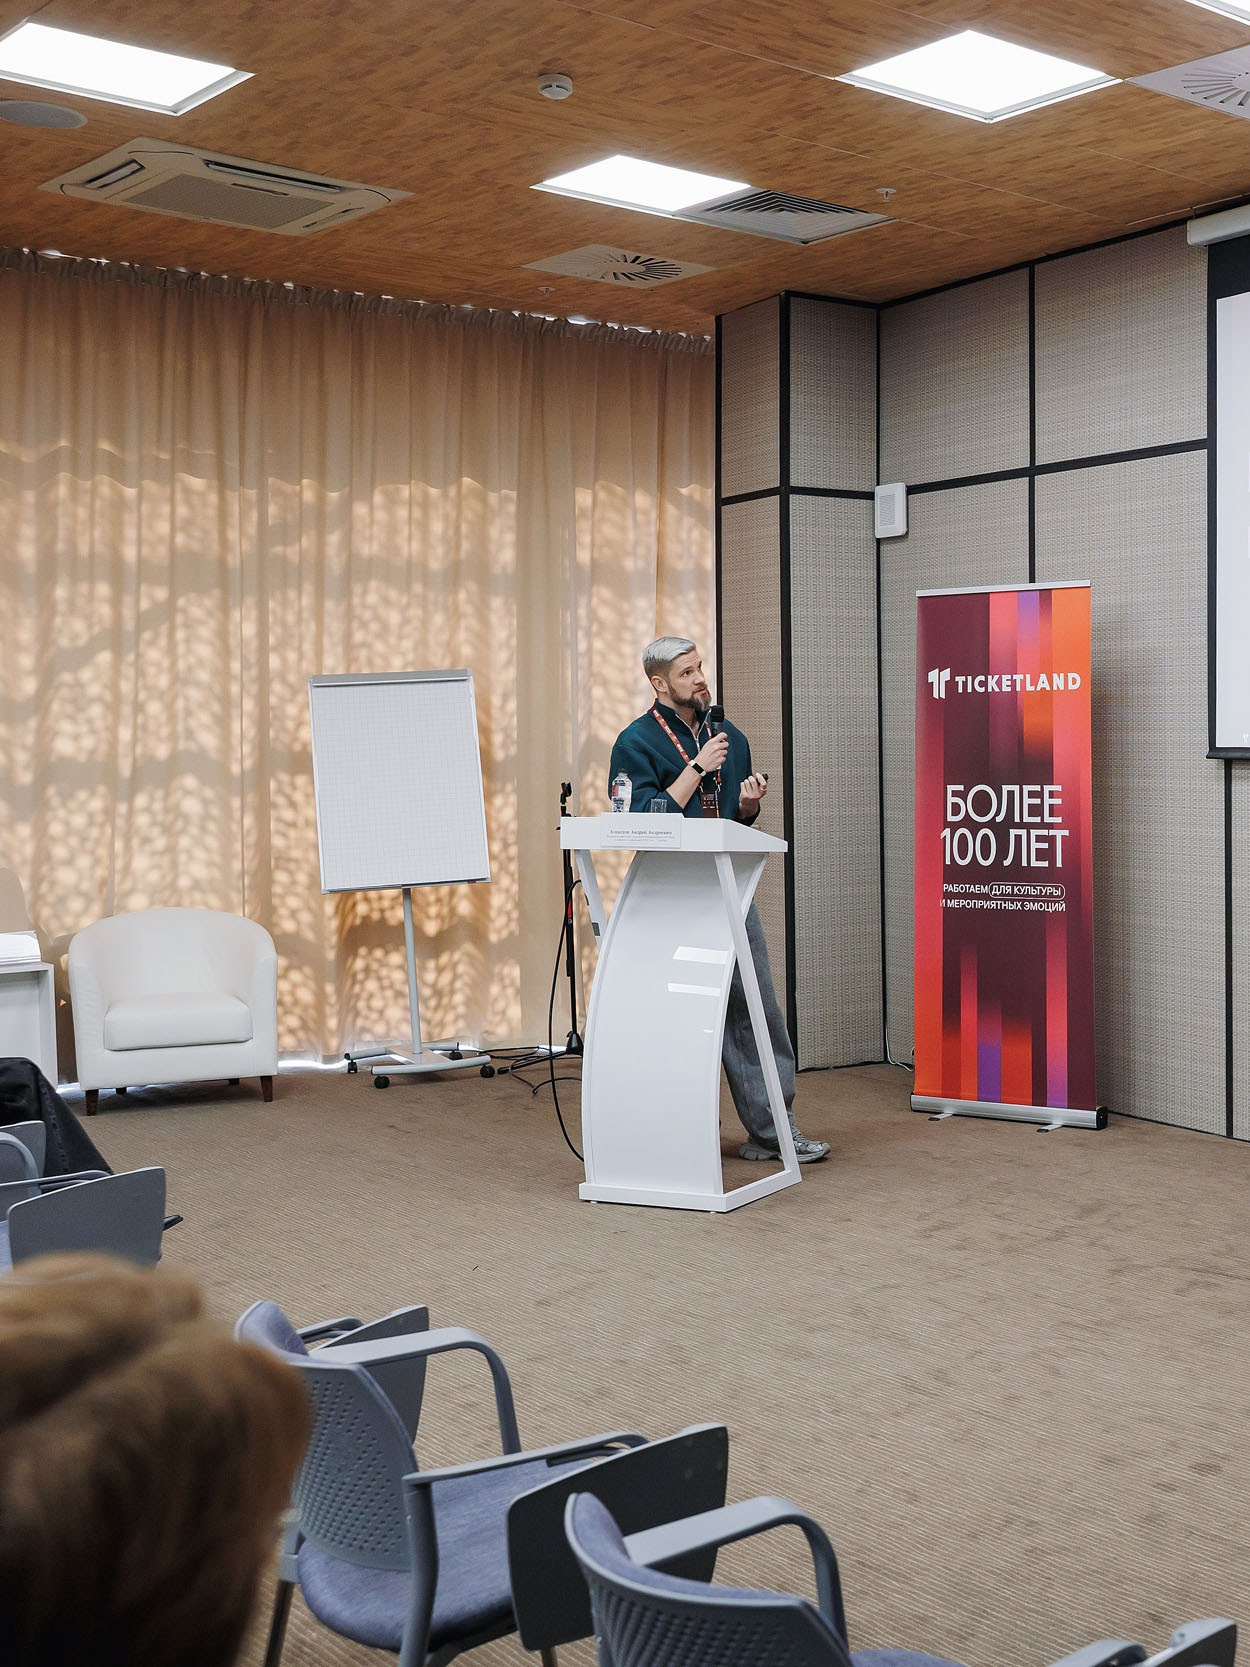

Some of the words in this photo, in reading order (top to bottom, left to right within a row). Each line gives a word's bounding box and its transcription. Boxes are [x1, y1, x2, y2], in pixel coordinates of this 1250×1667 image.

[955, 672, 1081, 694] TICKETLAND
[946, 784, 1063, 823] БОЛЕЕ
[940, 827, 997, 867] 100
[1003, 828, 1069, 868] ЛЕТ
[943, 883, 989, 894] РАБОТАЕМ
[991, 885, 1012, 896] ДЛЯ
[1013, 885, 1062, 897] КУЛЬТУРЫ
[940, 898, 946, 908] И
[947, 898, 1022, 910] МЕРОПРИЯТНЫХ
[1023, 900, 1066, 913] ЭМОЦИЙ
